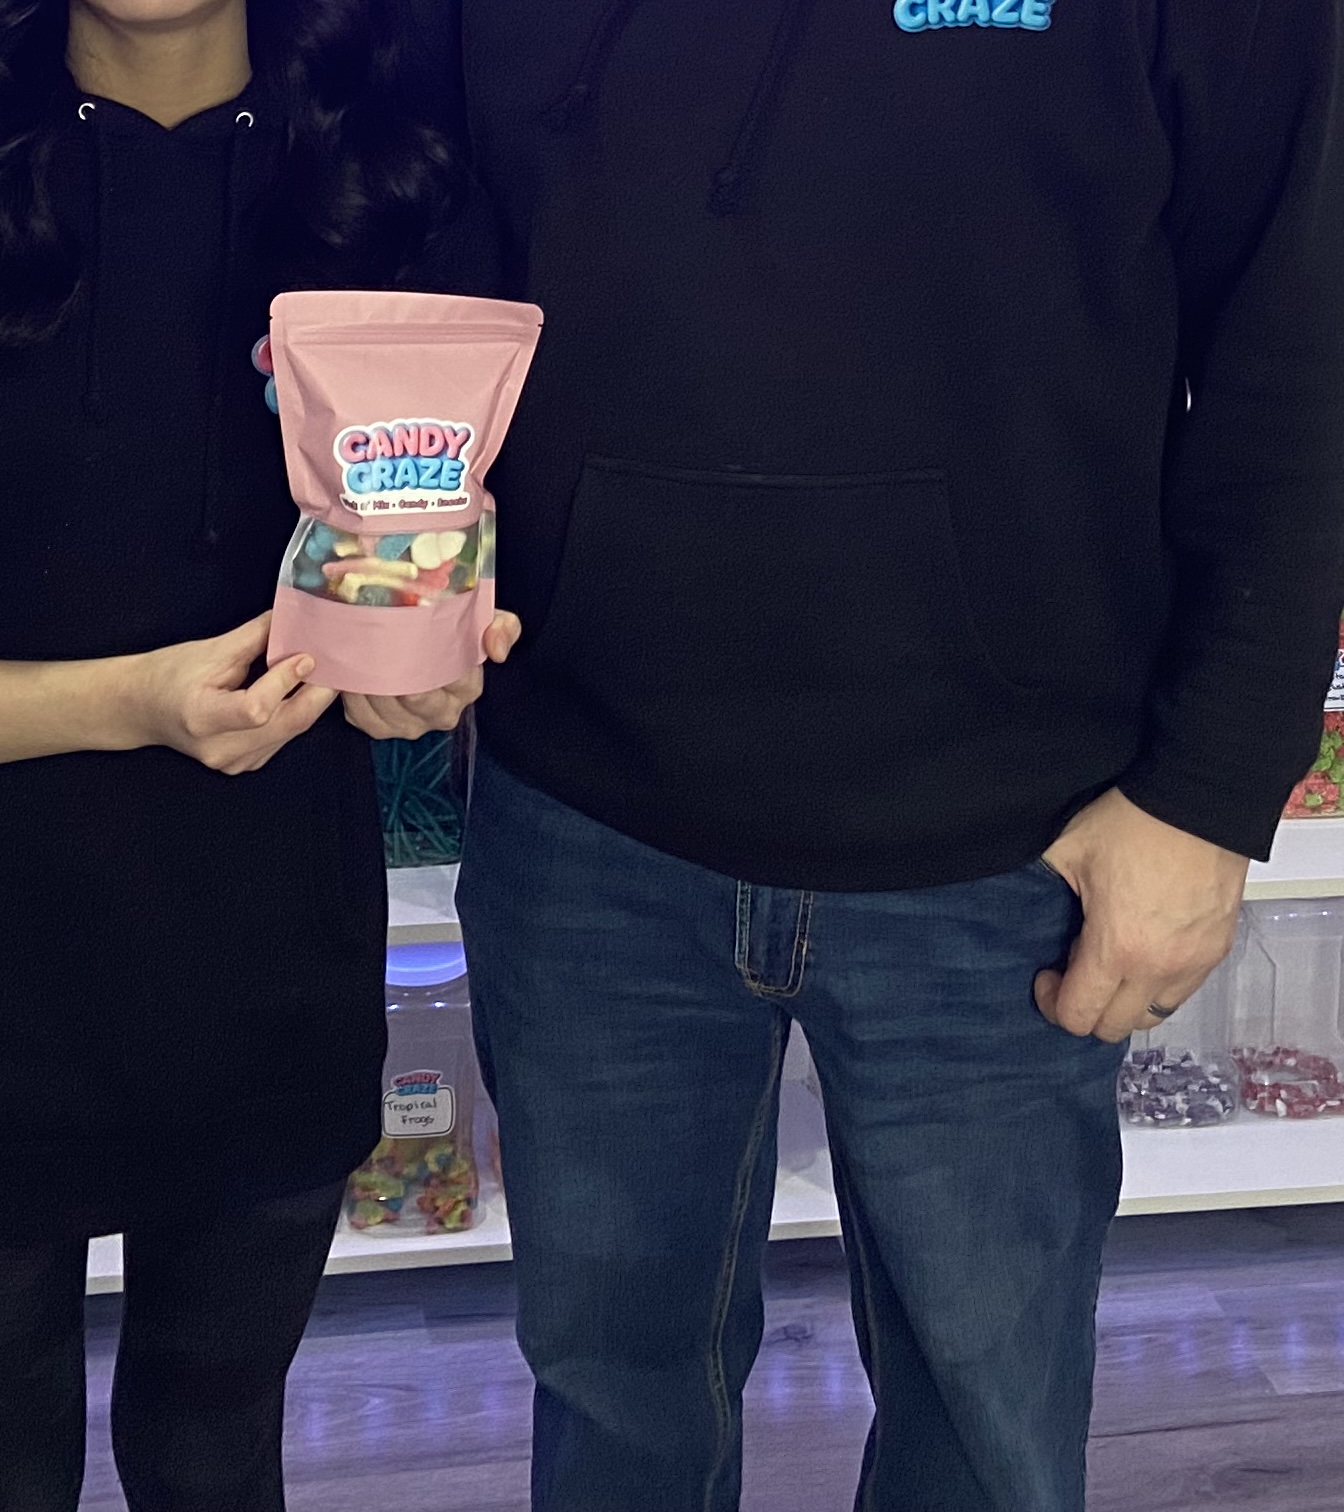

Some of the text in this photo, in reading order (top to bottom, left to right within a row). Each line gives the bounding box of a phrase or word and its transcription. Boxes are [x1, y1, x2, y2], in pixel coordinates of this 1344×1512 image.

[338, 422, 471, 463] CANDY
[347, 457, 464, 495] CRAZE
[384, 1098, 439, 1114] Tropical
